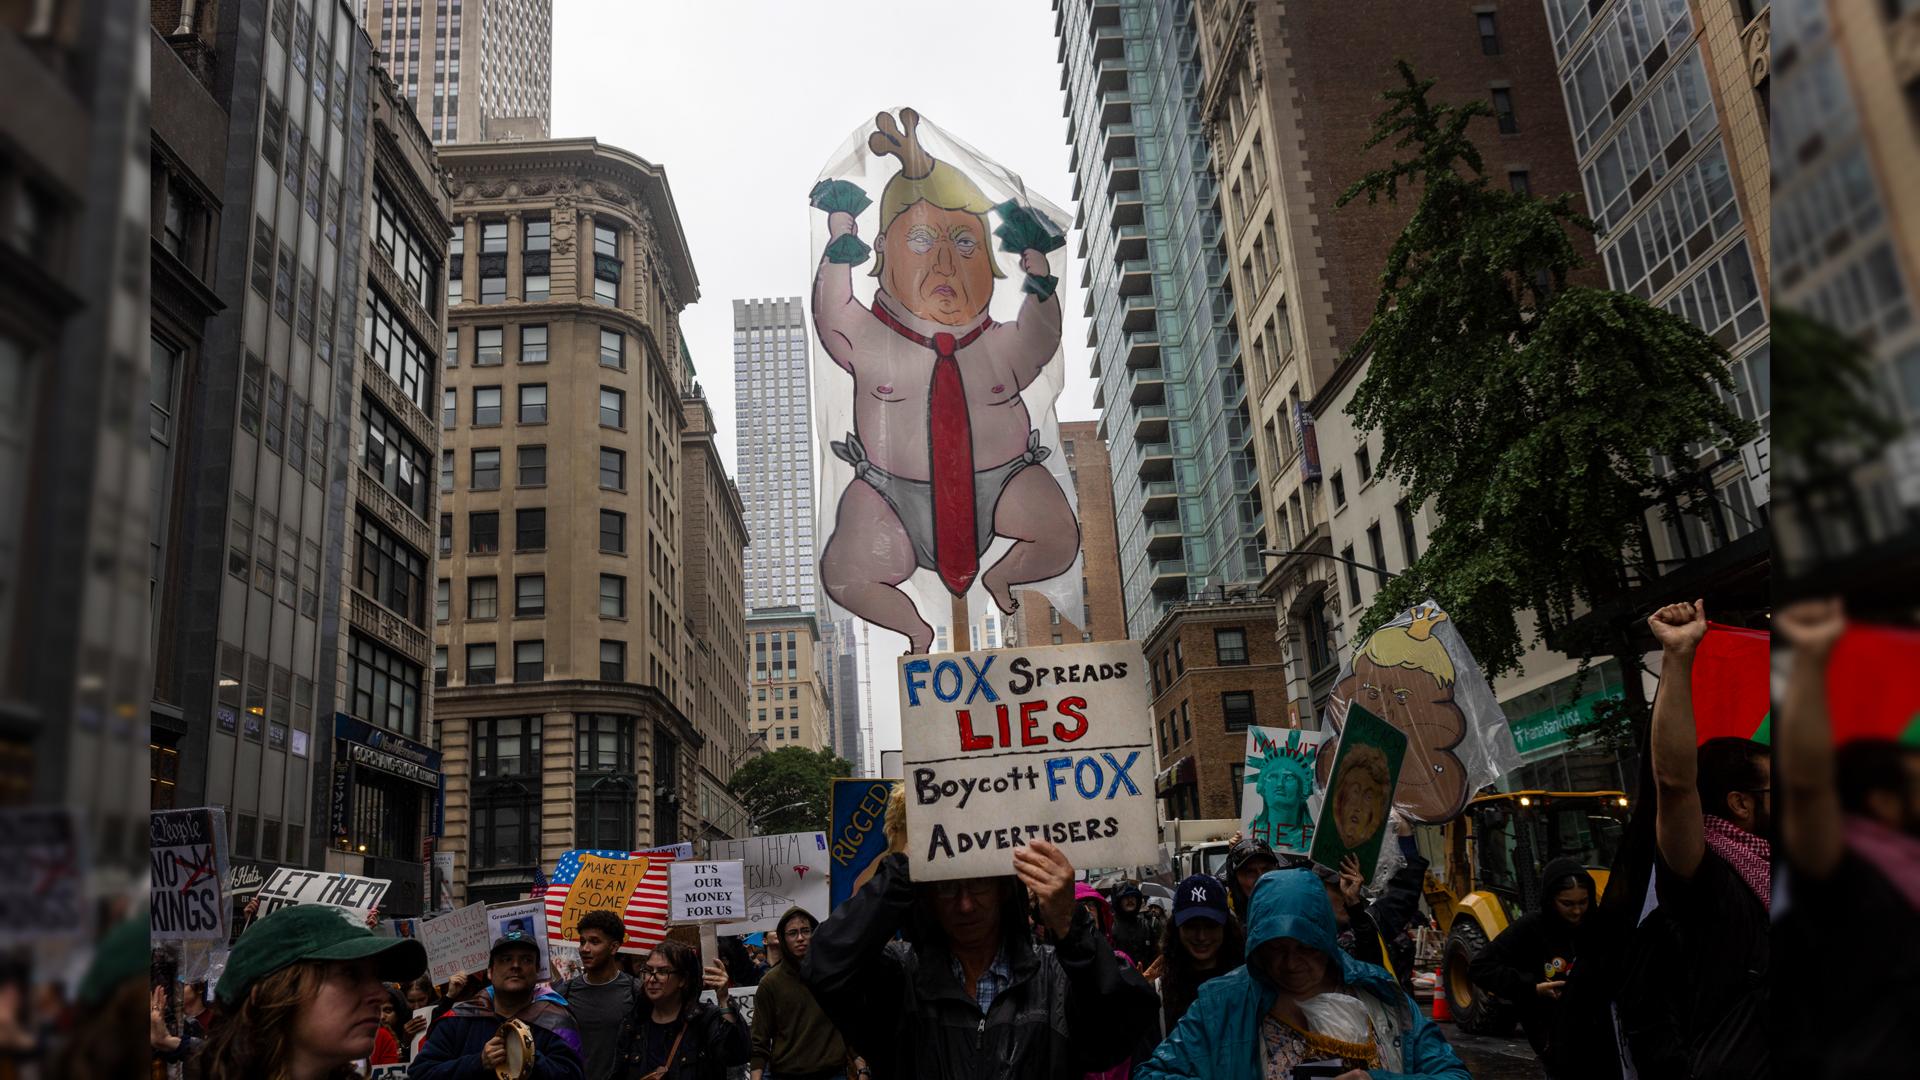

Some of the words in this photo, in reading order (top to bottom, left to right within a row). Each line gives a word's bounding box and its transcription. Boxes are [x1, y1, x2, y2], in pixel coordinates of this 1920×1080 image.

[1742, 434, 1770, 480] LE
[903, 655, 1000, 707] FOX
[1008, 656, 1128, 695] SPREADS
[956, 696, 1088, 752] LIES
[1285, 740, 1319, 758] WIT
[913, 765, 1040, 809] Boycott
[1044, 751, 1142, 801] FOX
[832, 783, 889, 867] RIGGED
[927, 816, 1120, 862] ADVERTISERS
[758, 834, 801, 866] THEM
[583, 861, 621, 877] MAKE
[624, 864, 641, 877] IT
[694, 865, 718, 875] IT'S
[260, 869, 320, 898] LET
[317, 875, 388, 909] THEM
[582, 877, 626, 893] MEAN
[694, 878, 722, 889] OUR
[575, 891, 624, 908] SOME
[685, 891, 732, 904] MONEY
[1191, 886, 1207, 903] NY
[686, 906, 714, 917] FOR
[716, 905, 732, 917] US
